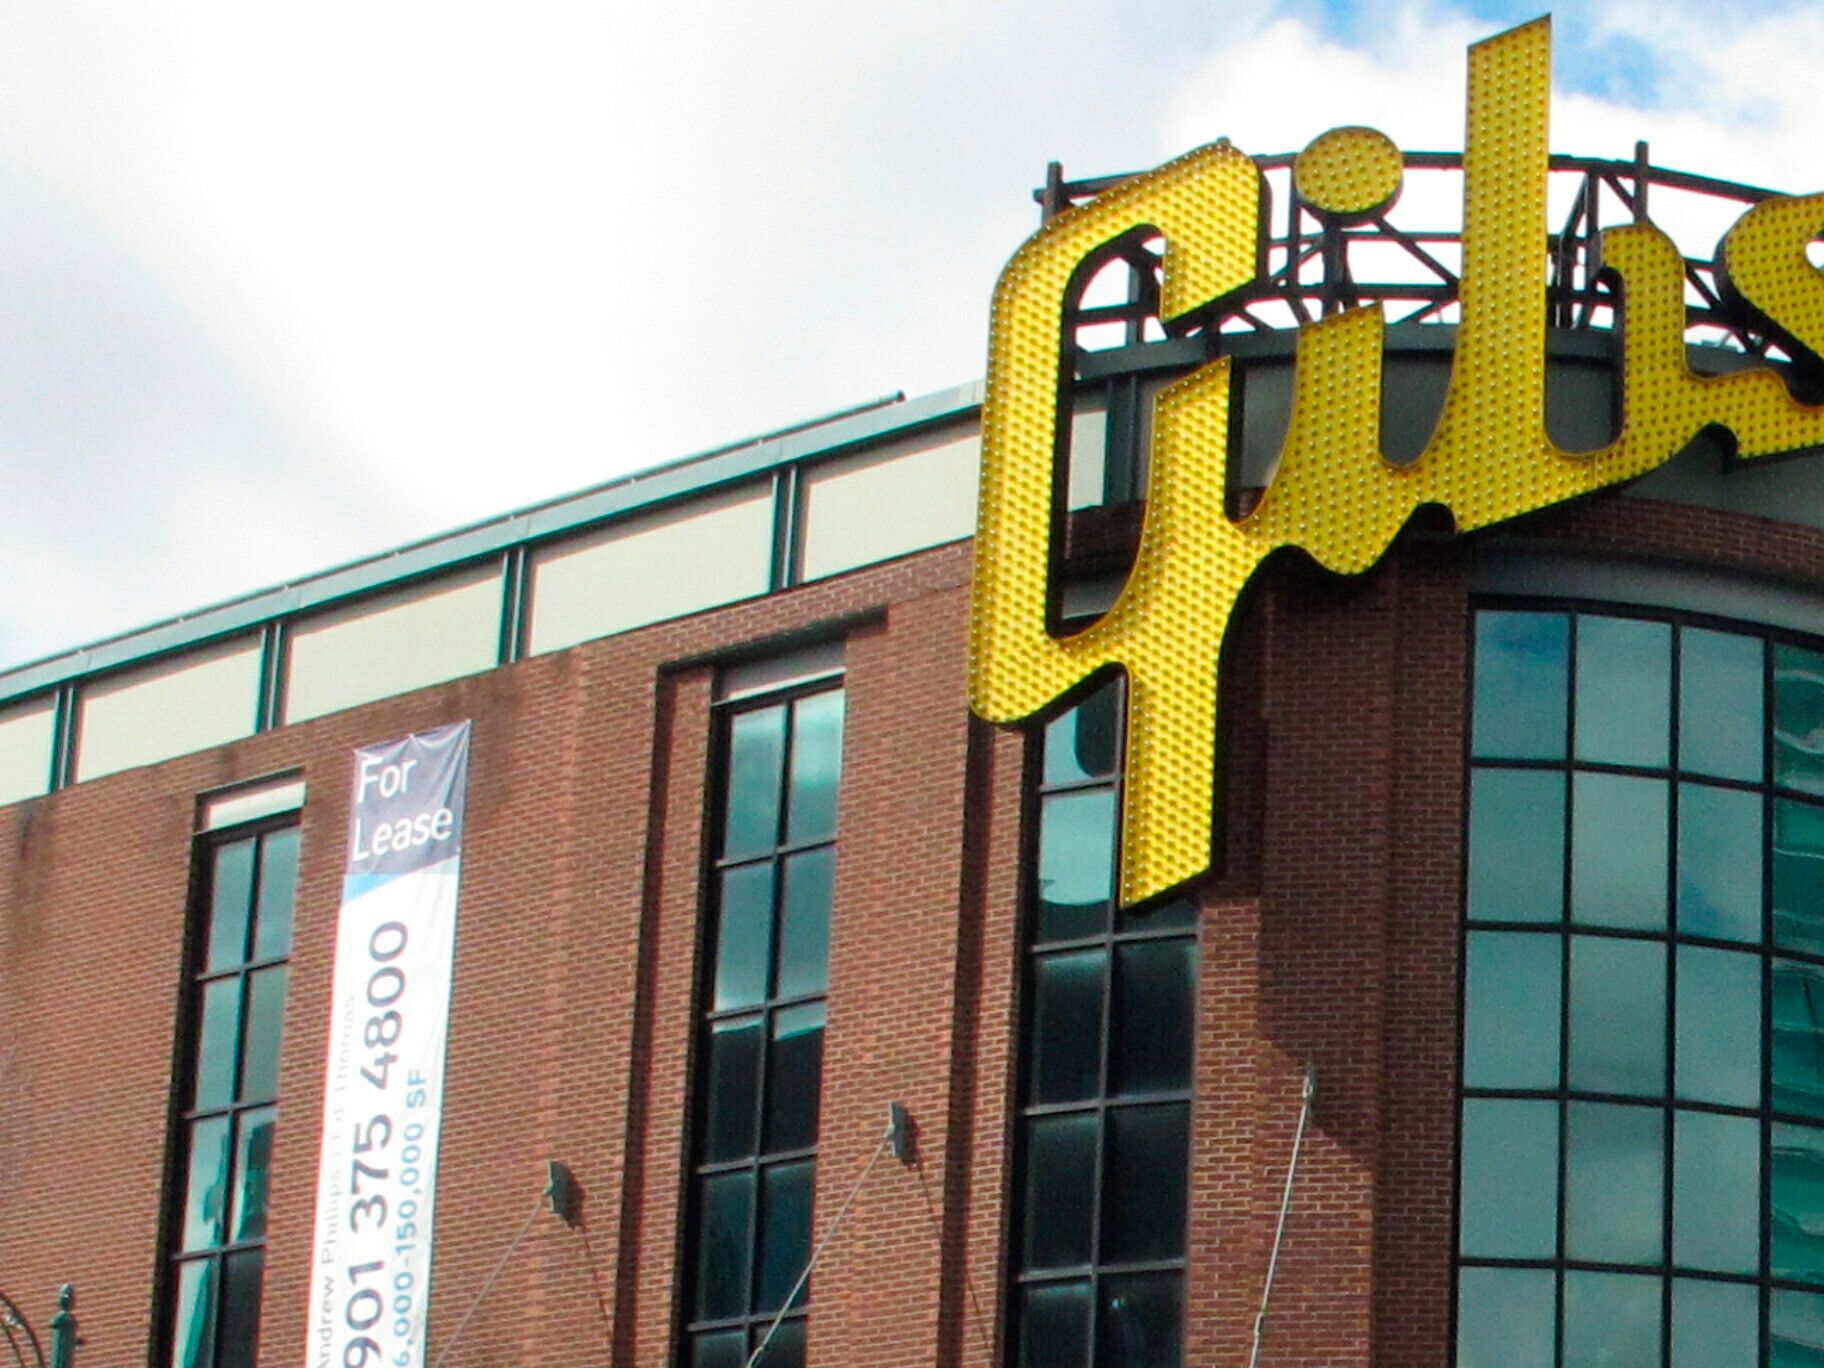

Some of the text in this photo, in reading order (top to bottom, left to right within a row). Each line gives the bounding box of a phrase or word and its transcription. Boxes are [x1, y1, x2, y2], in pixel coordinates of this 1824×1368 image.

[357, 757, 417, 804] For
[353, 807, 453, 862] Lease
[360, 920, 409, 1091] 4800
[404, 1067, 427, 1109] SF
[350, 1113, 393, 1235] 375
